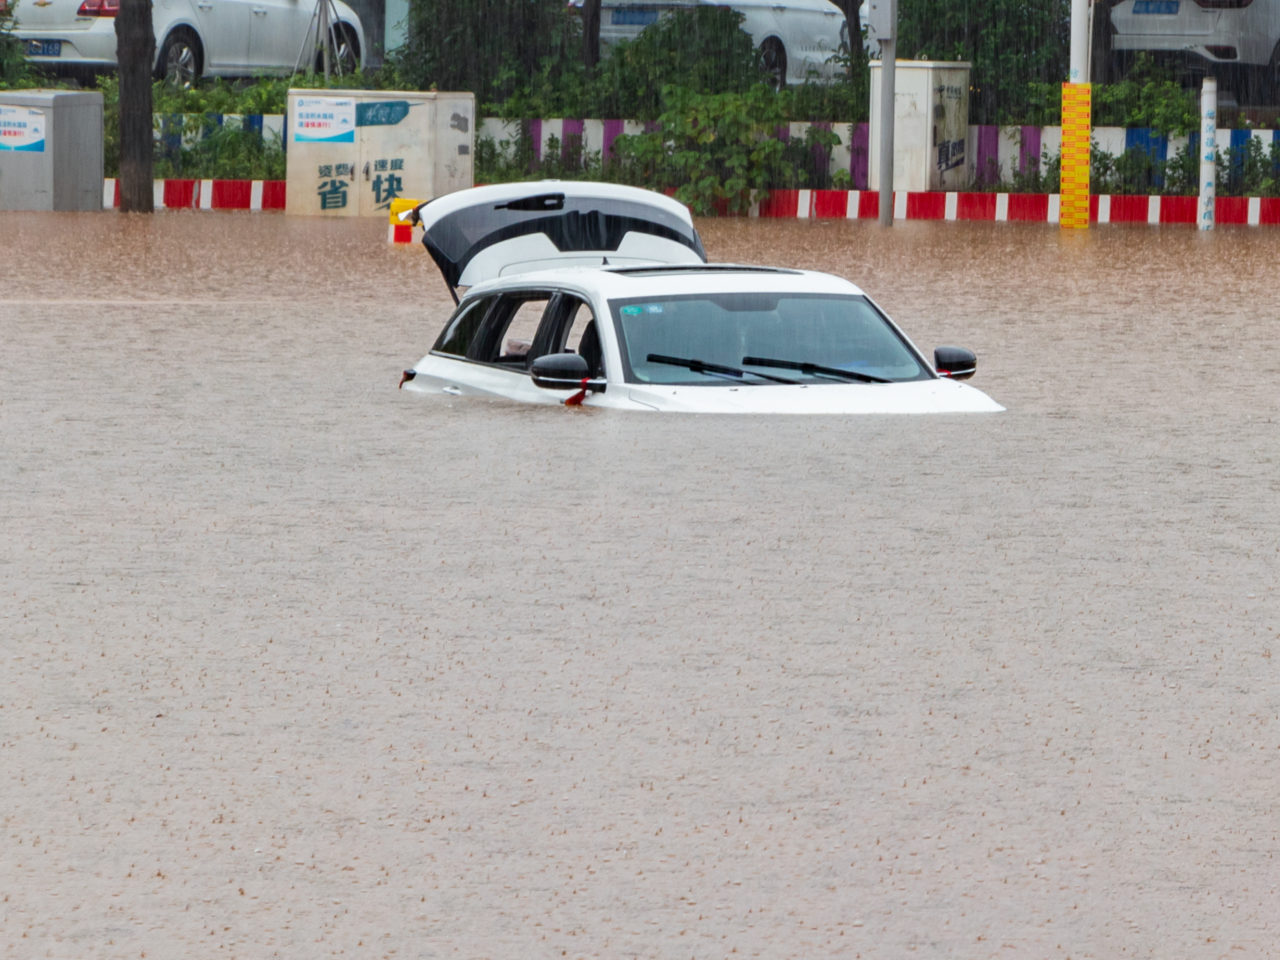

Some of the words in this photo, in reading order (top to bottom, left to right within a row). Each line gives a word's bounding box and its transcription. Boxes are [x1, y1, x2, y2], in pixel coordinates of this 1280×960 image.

[318, 163, 349, 179] 资费
[374, 158, 405, 172] 速度
[317, 179, 349, 211] 省
[371, 172, 404, 211] 快
